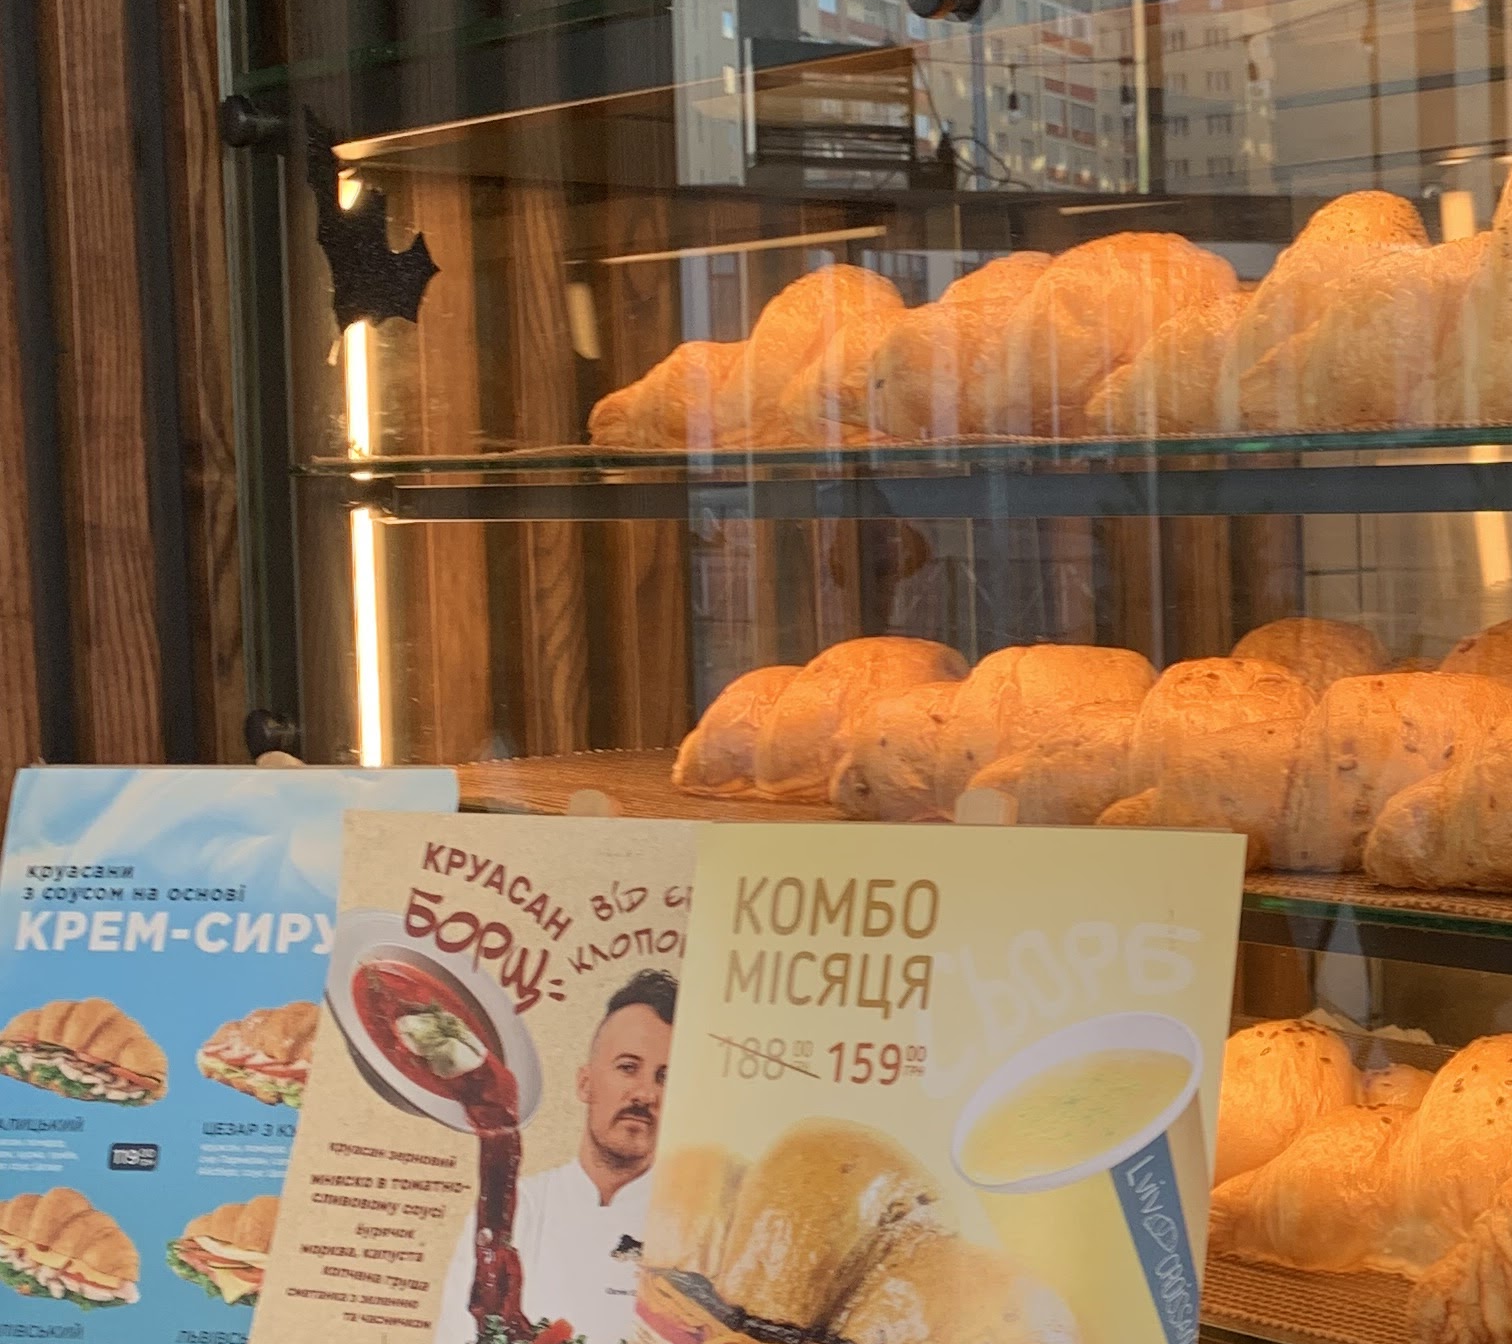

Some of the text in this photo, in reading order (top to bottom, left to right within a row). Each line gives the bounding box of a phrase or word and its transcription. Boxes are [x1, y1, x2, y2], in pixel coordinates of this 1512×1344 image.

[22, 885, 247, 903] з соусом на основі
[26, 865, 135, 882] круасани
[422, 841, 574, 941] КРУАСАН
[732, 875, 942, 940] КОМБО
[404, 887, 549, 1015] БОРЩ
[723, 949, 935, 1021] МІСЯЦЯ
[715, 1036, 928, 1086] 188 159 00
[202, 1121, 259, 1137] ЦЕЗАР
